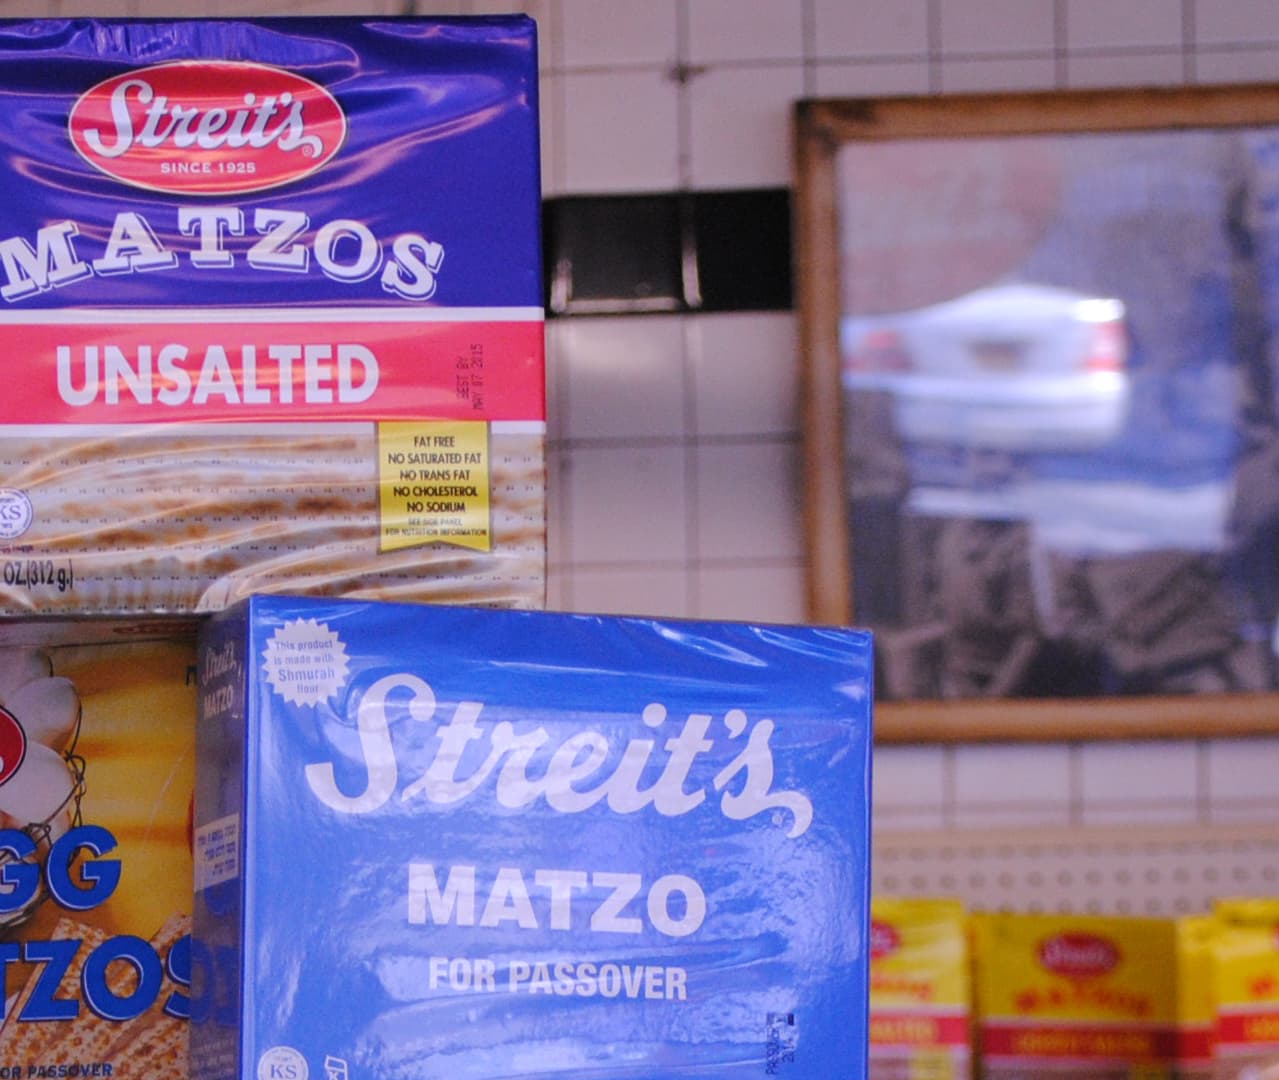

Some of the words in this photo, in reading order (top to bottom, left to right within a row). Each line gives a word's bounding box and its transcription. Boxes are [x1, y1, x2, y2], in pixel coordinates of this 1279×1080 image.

[83, 79, 323, 158] Streit's
[161, 162, 210, 174] SINCE
[219, 162, 256, 174] 1925
[56, 343, 380, 407] UNSALTED
[414, 436, 431, 447] FAT
[434, 436, 455, 447] FREE
[388, 453, 405, 464] NO
[408, 453, 462, 464] SATURATED
[464, 453, 481, 464] FAT
[400, 470, 416, 480] NO
[420, 470, 450, 480] TRANS
[453, 470, 470, 480] FAT
[393, 486, 410, 496] NO
[413, 486, 478, 496] CHOLESTEROL
[407, 502, 424, 512] NO
[426, 502, 465, 512] SODIUM
[275, 641, 295, 650] This
[297, 640, 333, 651] product
[278, 667, 335, 681] Shmurah
[304, 672, 814, 839] Streit's
[407, 863, 707, 937] MATZO
[428, 957, 496, 992] FOR
[509, 960, 687, 1000] PASSOVER
[28, 1063, 113, 1080] PASSOVER
[270, 1064, 297, 1079] KS
